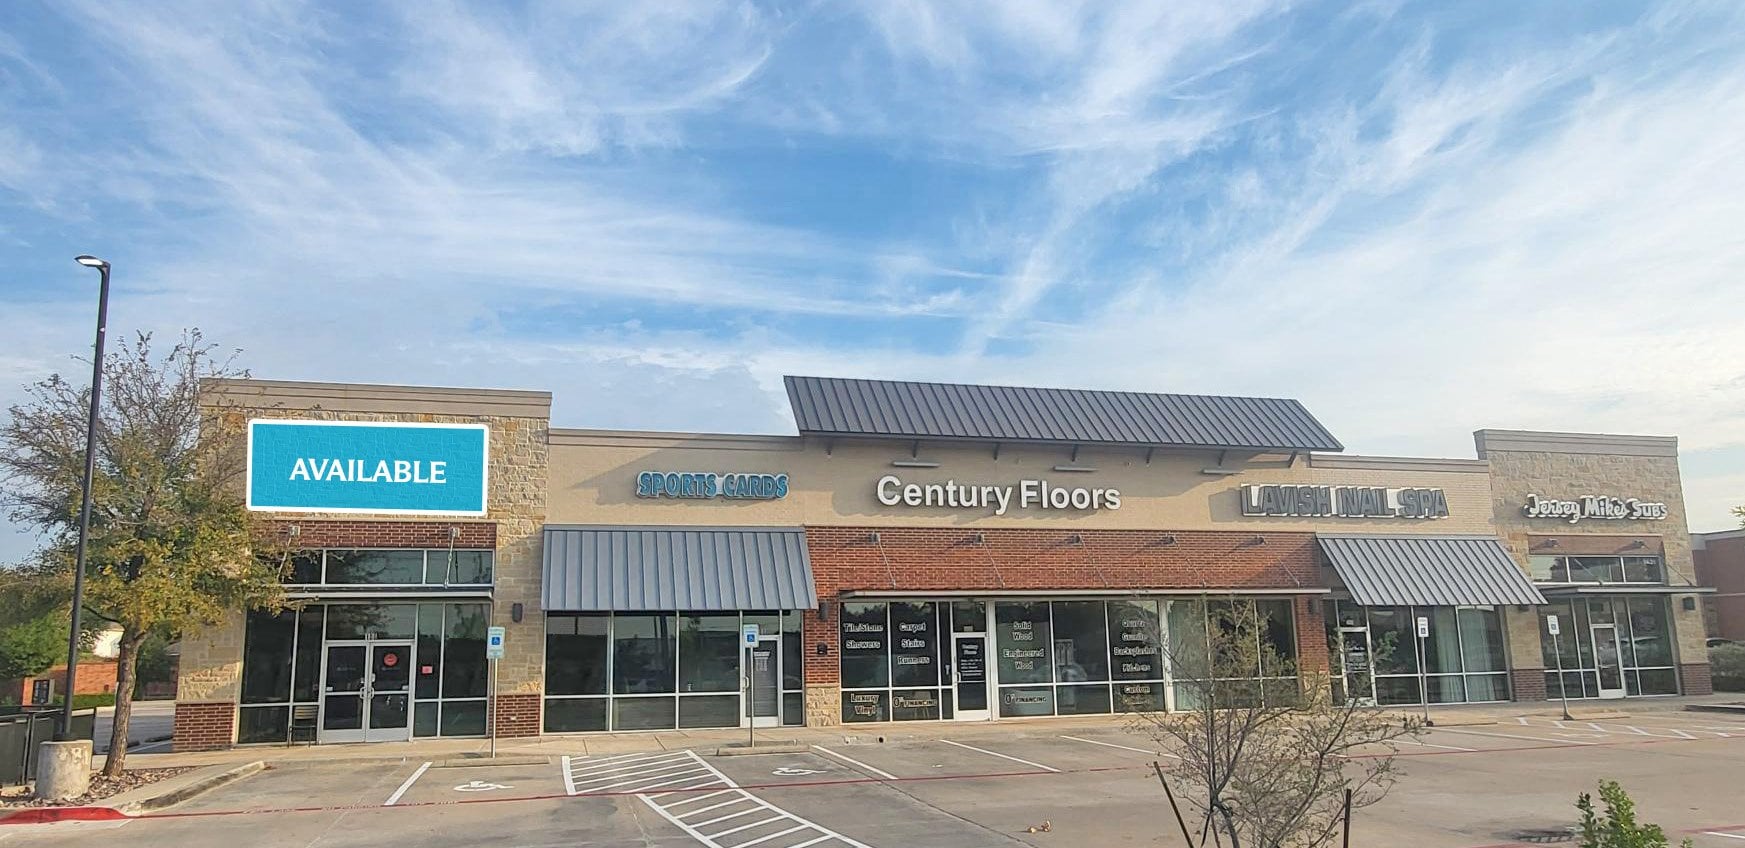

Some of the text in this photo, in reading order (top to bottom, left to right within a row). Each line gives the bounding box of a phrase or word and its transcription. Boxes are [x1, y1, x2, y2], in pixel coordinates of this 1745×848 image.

[637, 471, 789, 500] SPORTS CARDS
[877, 475, 1121, 515] Century Floors
[1240, 484, 1450, 519] LAVISH NAIL SPA
[1523, 493, 1581, 523] Jersey
[899, 621, 927, 633] Carpet
[1012, 631, 1034, 641] Wood
[845, 640, 881, 650] Showers
[901, 638, 926, 648] Stairs
[1003, 648, 1046, 658] Engineered
[1014, 661, 1034, 670] Wood
[850, 693, 880, 704] Luxury
[1015, 696, 1047, 704] FINANCING
[854, 705, 876, 716] Vinyl
